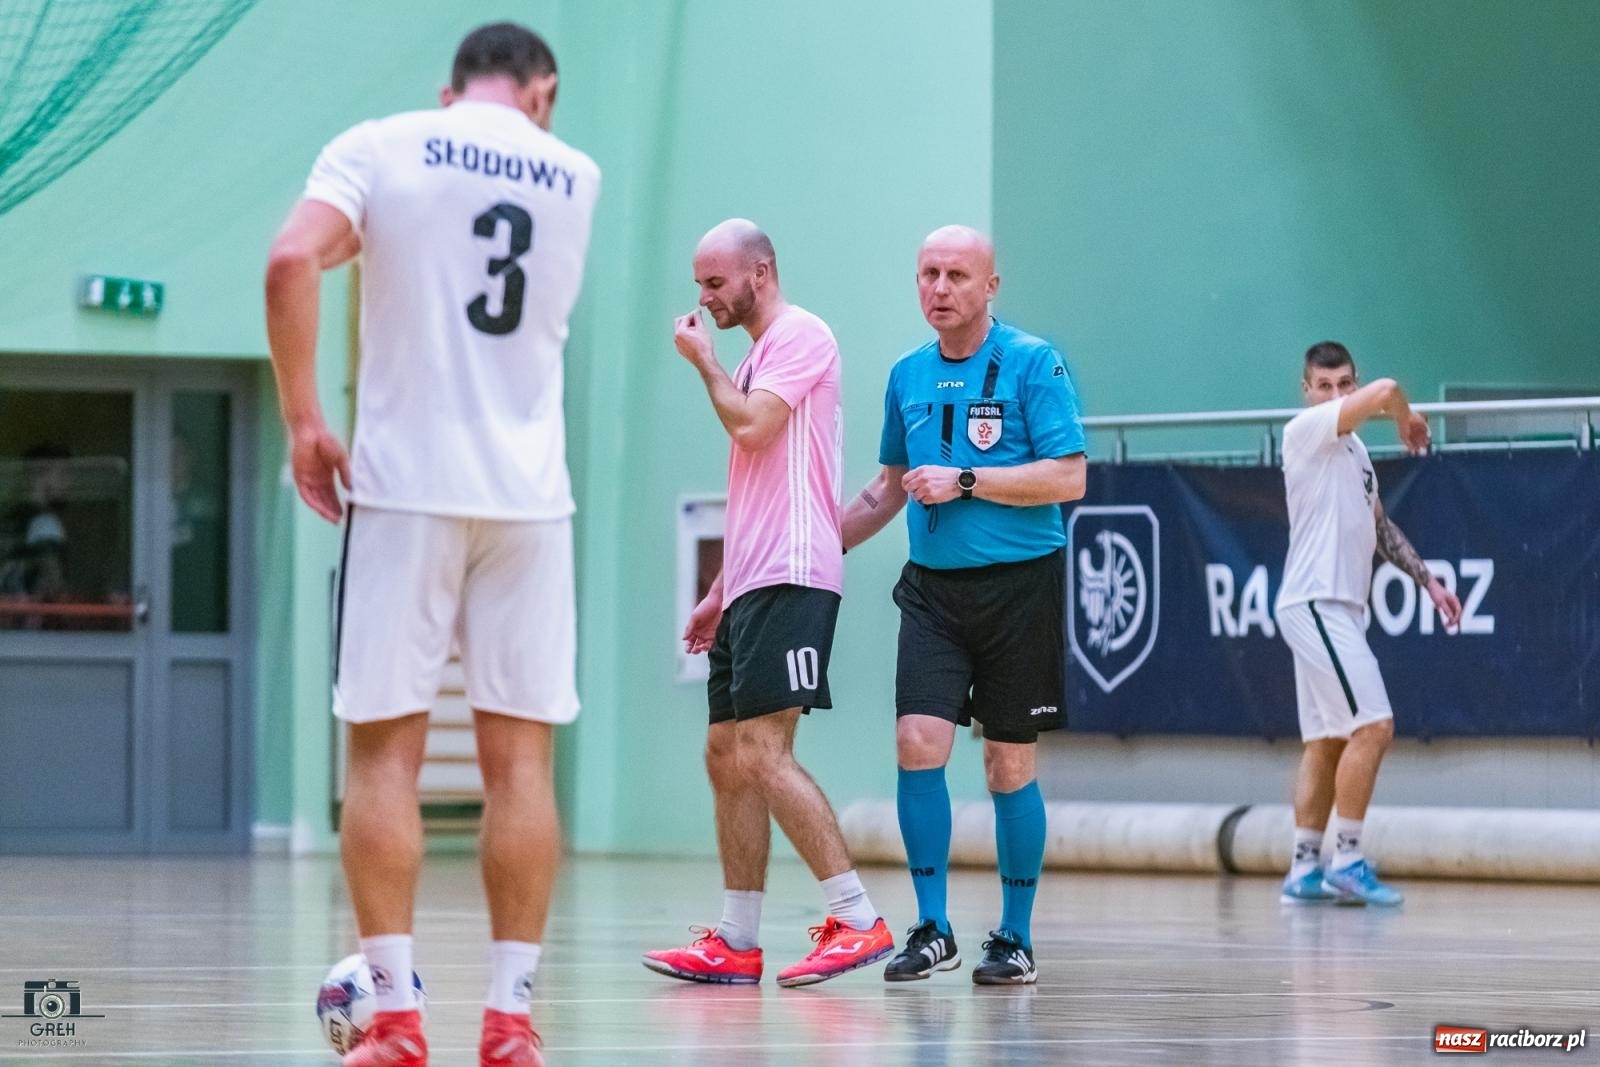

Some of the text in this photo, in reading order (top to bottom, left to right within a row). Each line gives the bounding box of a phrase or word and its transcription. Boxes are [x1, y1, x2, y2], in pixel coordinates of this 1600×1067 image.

[424, 137, 576, 198] SŁODOWY
[467, 202, 532, 335] 3
[970, 406, 1002, 416] FUTSAL
[1205, 557, 1495, 637] RAORZ
[786, 646, 819, 692] 10
[910, 867, 935, 877] ina
